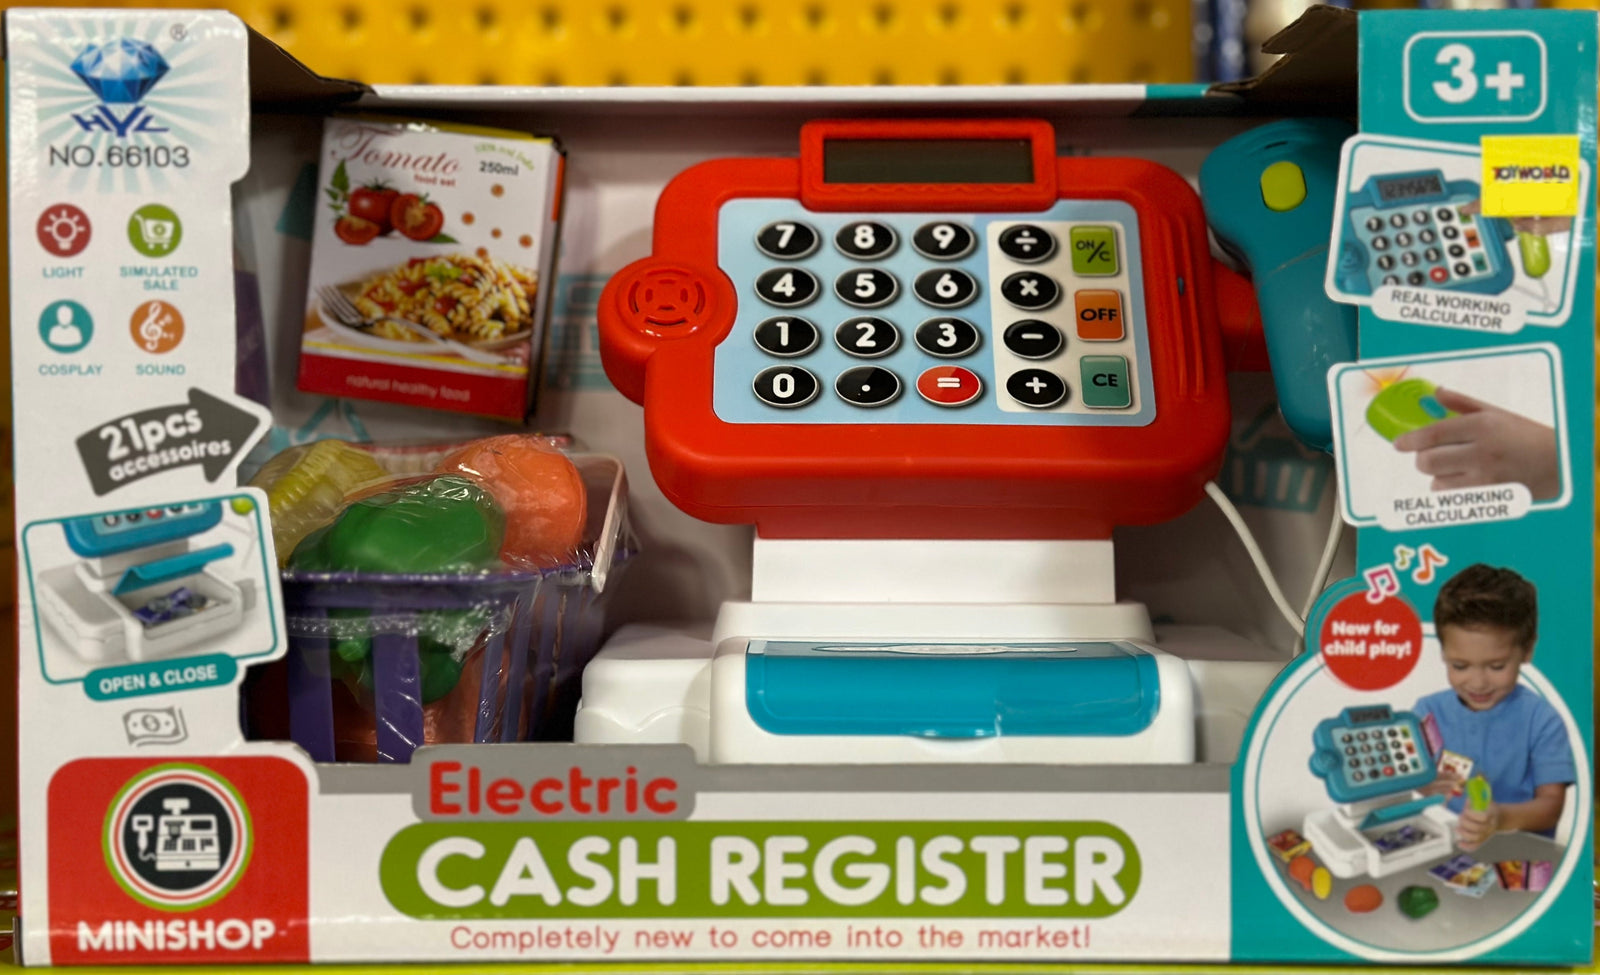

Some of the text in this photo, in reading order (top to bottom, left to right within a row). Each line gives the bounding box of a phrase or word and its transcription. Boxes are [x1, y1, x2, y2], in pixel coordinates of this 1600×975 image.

[1432, 43, 1525, 103] 3+
[50, 145, 190, 168] NO.66103
[331, 124, 459, 173] Tomato
[480, 161, 519, 176] 250ml
[1492, 164, 1570, 181] TOYWORLD
[775, 225, 796, 248] 7
[854, 225, 876, 249] 8
[932, 225, 955, 249] 9
[43, 267, 84, 278] LIGHT
[120, 266, 198, 278] SIMULATED
[143, 280, 179, 291] SALE
[772, 273, 796, 297] 4
[855, 274, 876, 297] 5
[936, 274, 958, 298] 6
[1080, 308, 1117, 321] OFF
[1391, 289, 1511, 316] REAL WORKING
[1400, 305, 1502, 329] CALCULATOR
[776, 322, 789, 346] 1
[856, 322, 876, 347] 2
[937, 322, 957, 348] 3
[38, 364, 103, 376] COSPLAY
[136, 364, 186, 375] SOUND
[1092, 373, 1118, 387] CE
[346, 375, 390, 391] natural
[440, 385, 471, 402] food
[773, 373, 795, 398] 0
[100, 409, 202, 460] 21pcs
[109, 439, 231, 481] accessoires
[1394, 489, 1514, 512] REAL WORKING
[1406, 505, 1509, 526] CALCULATOR
[1332, 620, 1400, 636] New for
[1325, 641, 1412, 660] child play!
[99, 664, 218, 694] OPEN & CLOSE
[429, 761, 678, 815] Electric
[416, 835, 1126, 907] CASH REGISTER
[77, 919, 276, 952] MINISHOP
[450, 925, 1091, 954] Completely new to come into the market!
